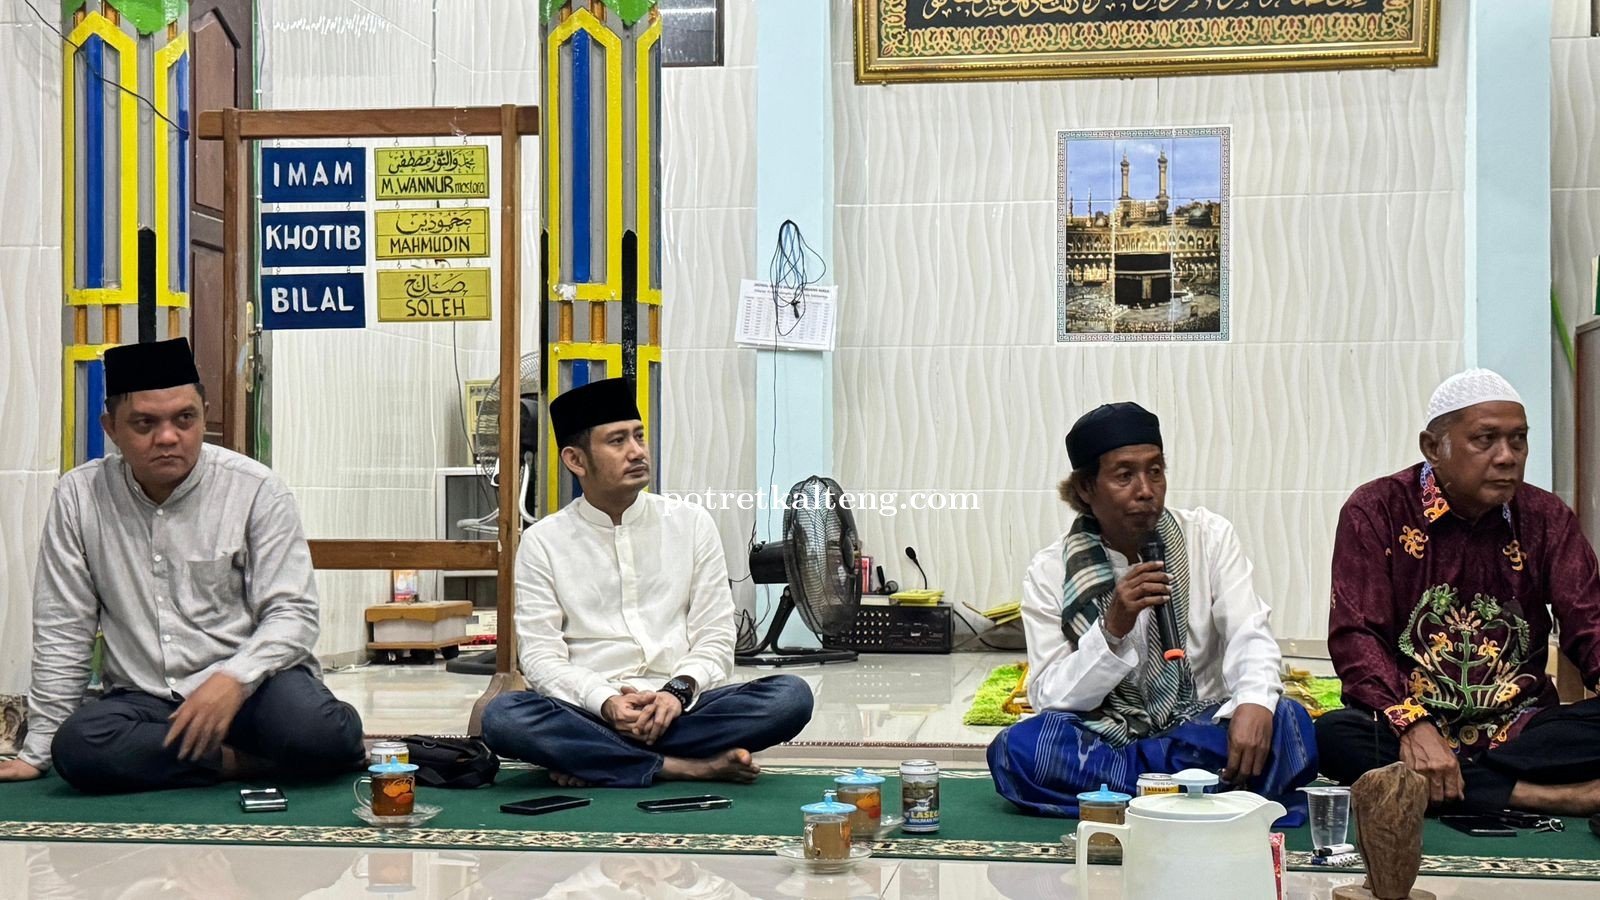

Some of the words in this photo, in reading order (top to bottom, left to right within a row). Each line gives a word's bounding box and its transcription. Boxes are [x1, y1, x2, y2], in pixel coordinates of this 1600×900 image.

[273, 161, 353, 188] IMAM
[265, 224, 361, 251] KHOTIB
[390, 235, 471, 254] MAHMUDIN
[271, 286, 355, 313] BILAL
[405, 298, 466, 317] SOLEH
